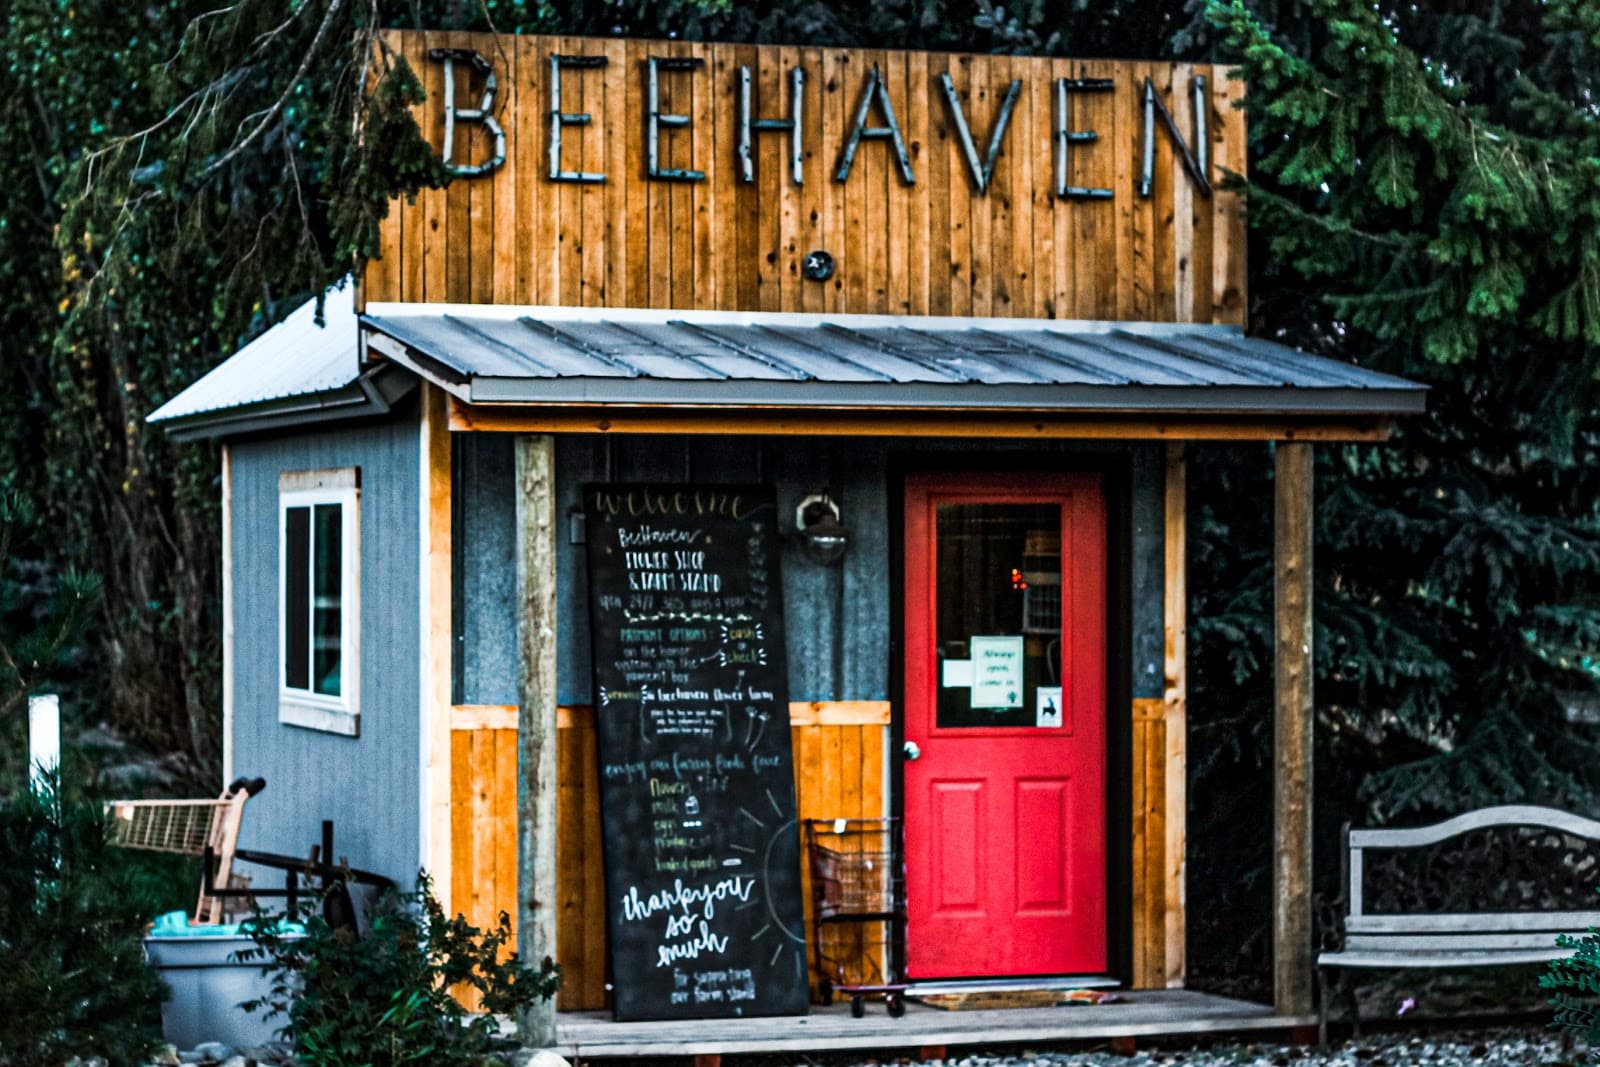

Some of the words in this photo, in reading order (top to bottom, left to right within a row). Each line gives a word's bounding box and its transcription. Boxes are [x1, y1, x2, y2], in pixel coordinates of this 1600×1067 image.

[428, 48, 1213, 198] BEEHAVEN
[594, 487, 752, 520] welcome
[625, 551, 669, 570] FLOWER
[674, 550, 706, 571] SHOP
[628, 573, 638, 590] &
[641, 572, 676, 591] FARM
[680, 572, 723, 593] STAND
[664, 912, 700, 939] so
[656, 920, 729, 968] much
